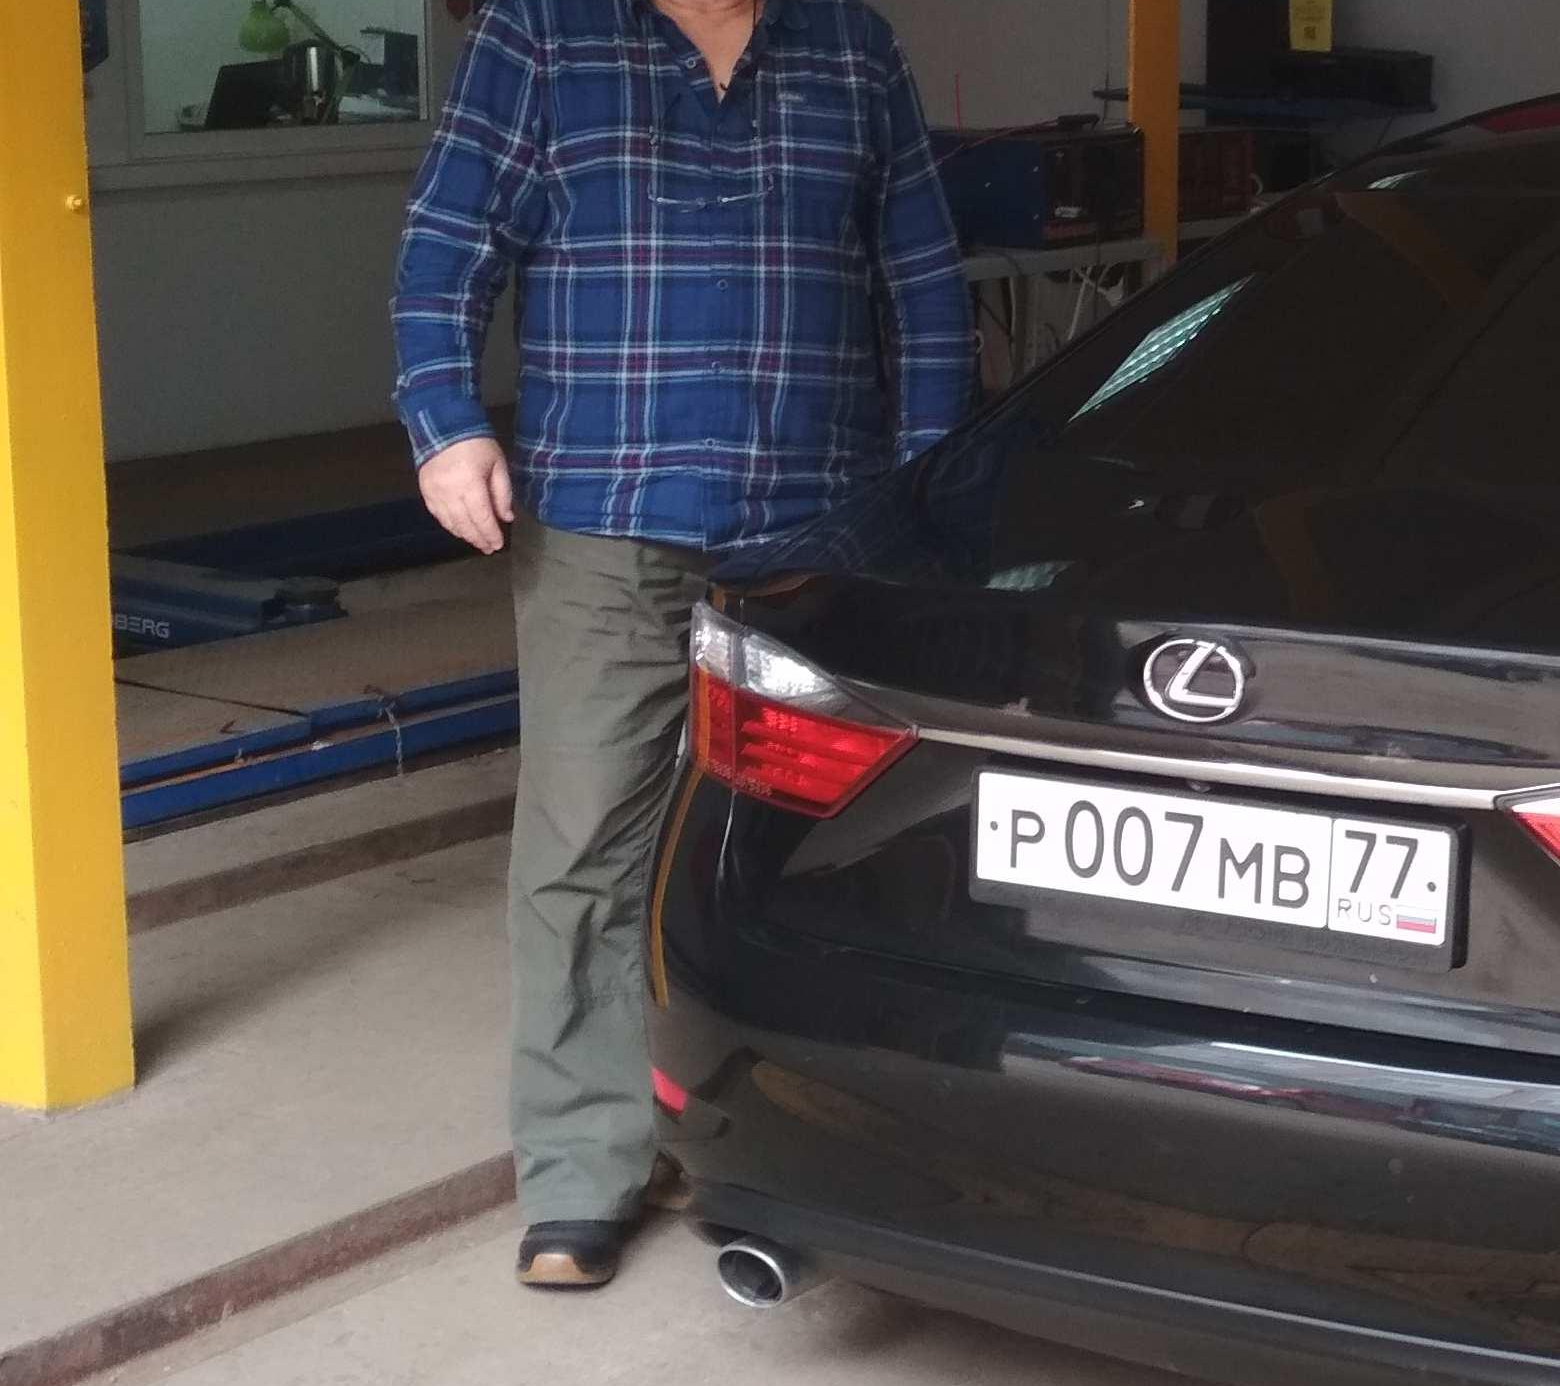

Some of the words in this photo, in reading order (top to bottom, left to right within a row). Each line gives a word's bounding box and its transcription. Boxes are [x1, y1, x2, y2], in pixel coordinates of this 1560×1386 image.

[115, 614, 170, 639] BERG
[1344, 830, 1419, 900] 77
[1337, 897, 1392, 926] RUS
